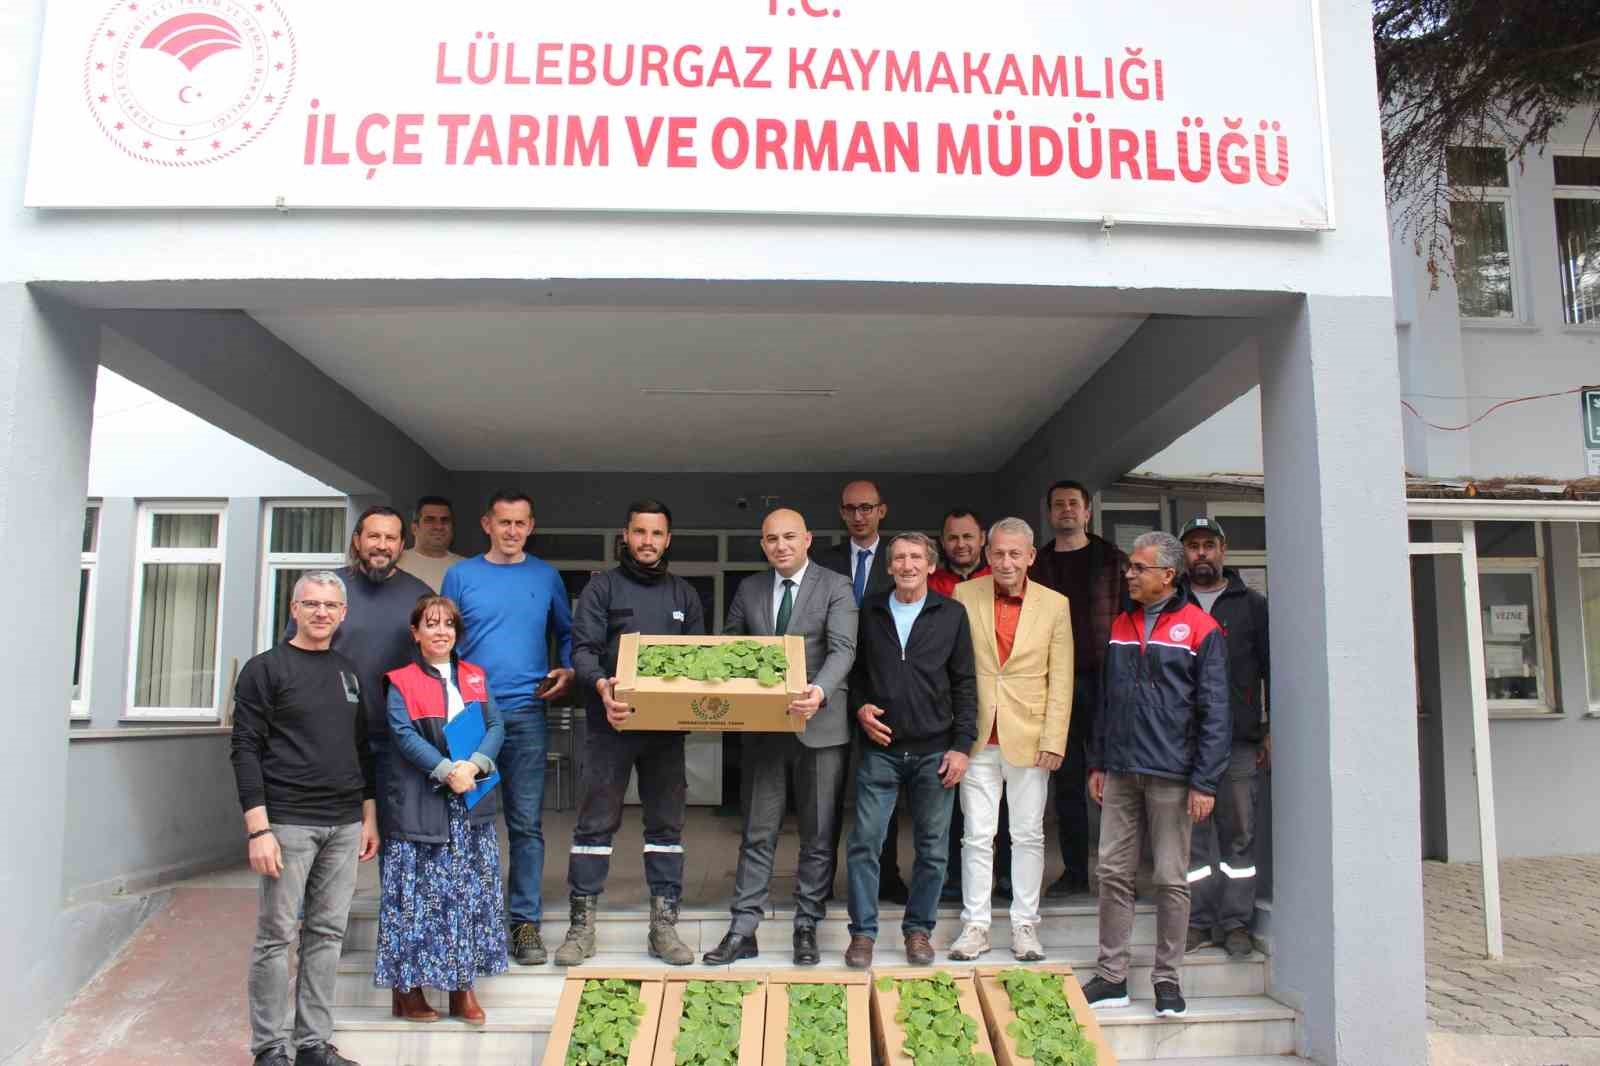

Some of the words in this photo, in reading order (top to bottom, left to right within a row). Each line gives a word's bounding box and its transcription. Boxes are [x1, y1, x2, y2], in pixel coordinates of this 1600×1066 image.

[436, 32, 773, 88] LÜLEBURGAZ
[788, 48, 1164, 101] KAYMAKAMLIĞI
[304, 99, 424, 180] İLÇE
[437, 114, 609, 167] TARIM
[624, 116, 697, 168] VE
[711, 117, 920, 173] ORMAN
[937, 110, 1289, 186] MÜDÜRLÜĞÜ
